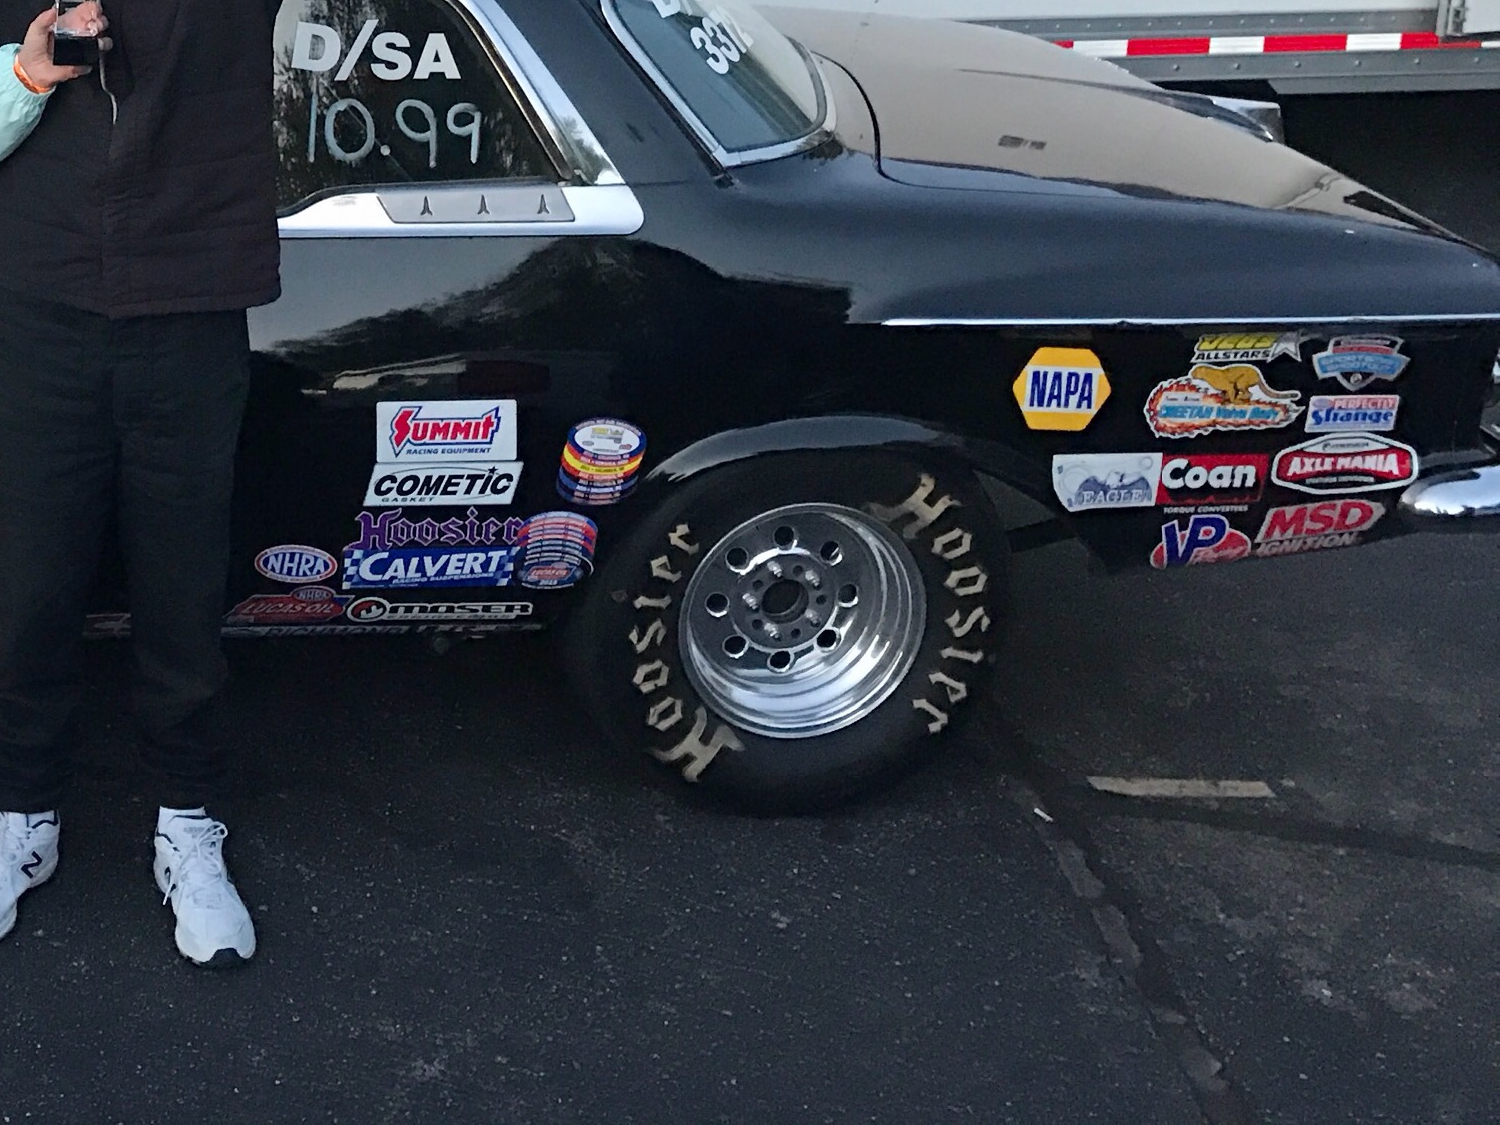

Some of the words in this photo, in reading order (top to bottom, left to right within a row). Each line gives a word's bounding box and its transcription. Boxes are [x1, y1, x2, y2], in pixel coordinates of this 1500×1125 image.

[291, 19, 462, 81] D/SA
[306, 97, 484, 169] 10.99
[1195, 349, 1271, 360] ALLSTARS
[1029, 370, 1094, 410] NAPA
[406, 447, 438, 455] RACING
[441, 447, 492, 455] EQUIPMENT
[1287, 457, 1335, 476] AXLE
[1336, 454, 1400, 476] MANIA
[374, 473, 514, 497] COMETIC
[1161, 458, 1257, 490] Coan
[1081, 489, 1143, 505] EAGLE
[342, 506, 525, 552] Hoosier
[1264, 501, 1374, 540] MSD
[1161, 513, 1230, 567] VP
[266, 552, 326, 577] NHRA
[358, 550, 508, 582] CALVERT
[242, 602, 302, 614] LUCAS
[304, 602, 335, 614] OIL
